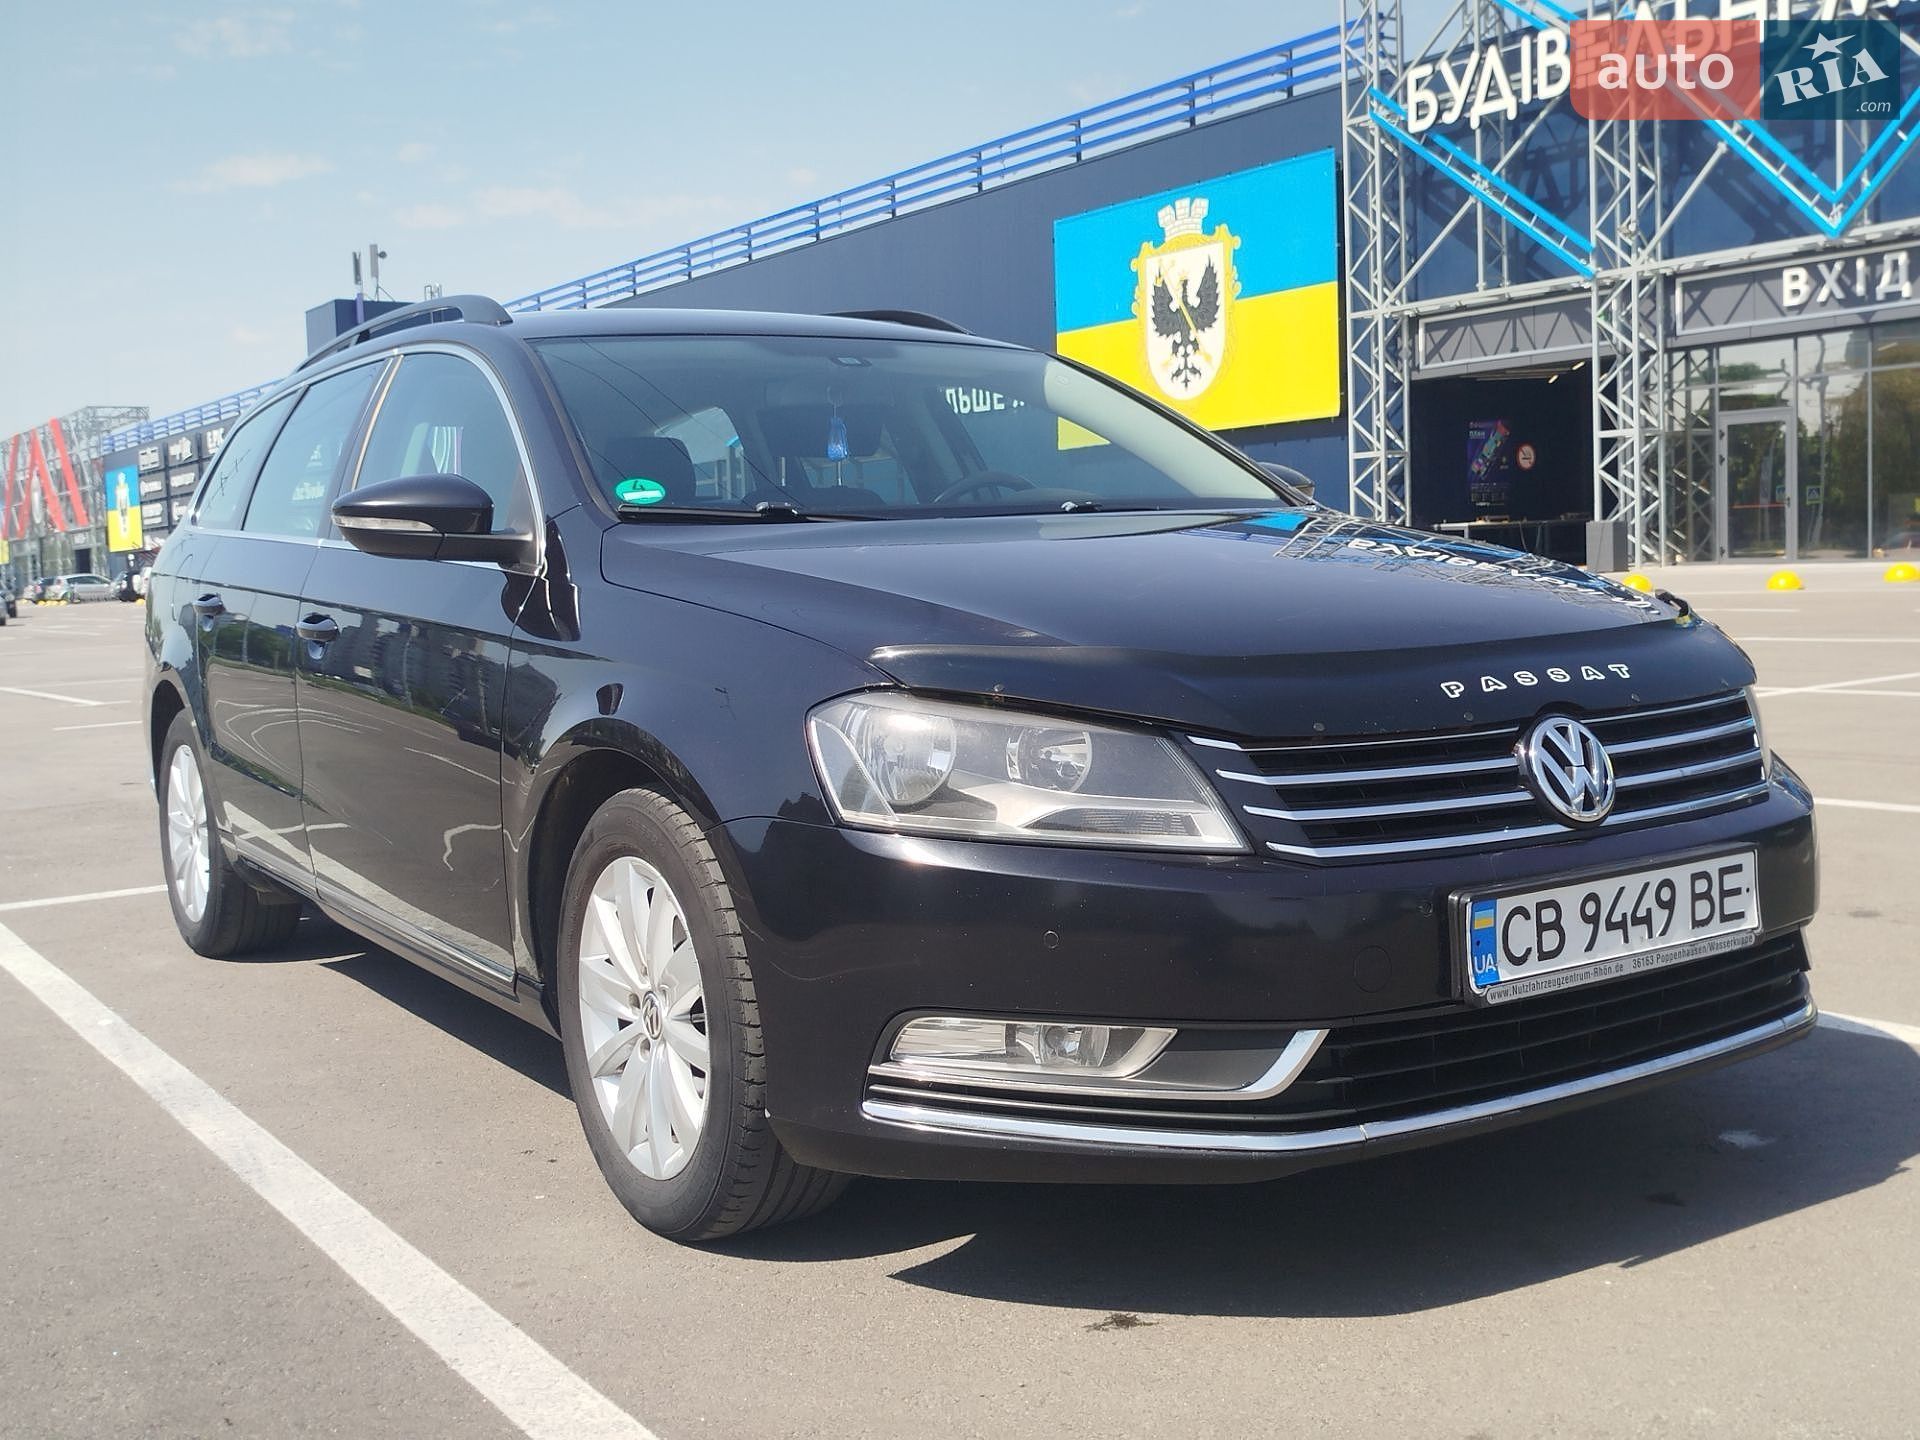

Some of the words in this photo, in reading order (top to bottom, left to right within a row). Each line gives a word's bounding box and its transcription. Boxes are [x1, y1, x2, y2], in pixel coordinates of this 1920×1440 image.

[1782, 250, 1913, 307] ВХІД
[1441, 663, 1631, 698] PASSAT
[1501, 898, 1567, 967] CB
[1579, 878, 1677, 953] 9449
[1690, 863, 1746, 930] BE
[1474, 953, 1497, 975] UA
